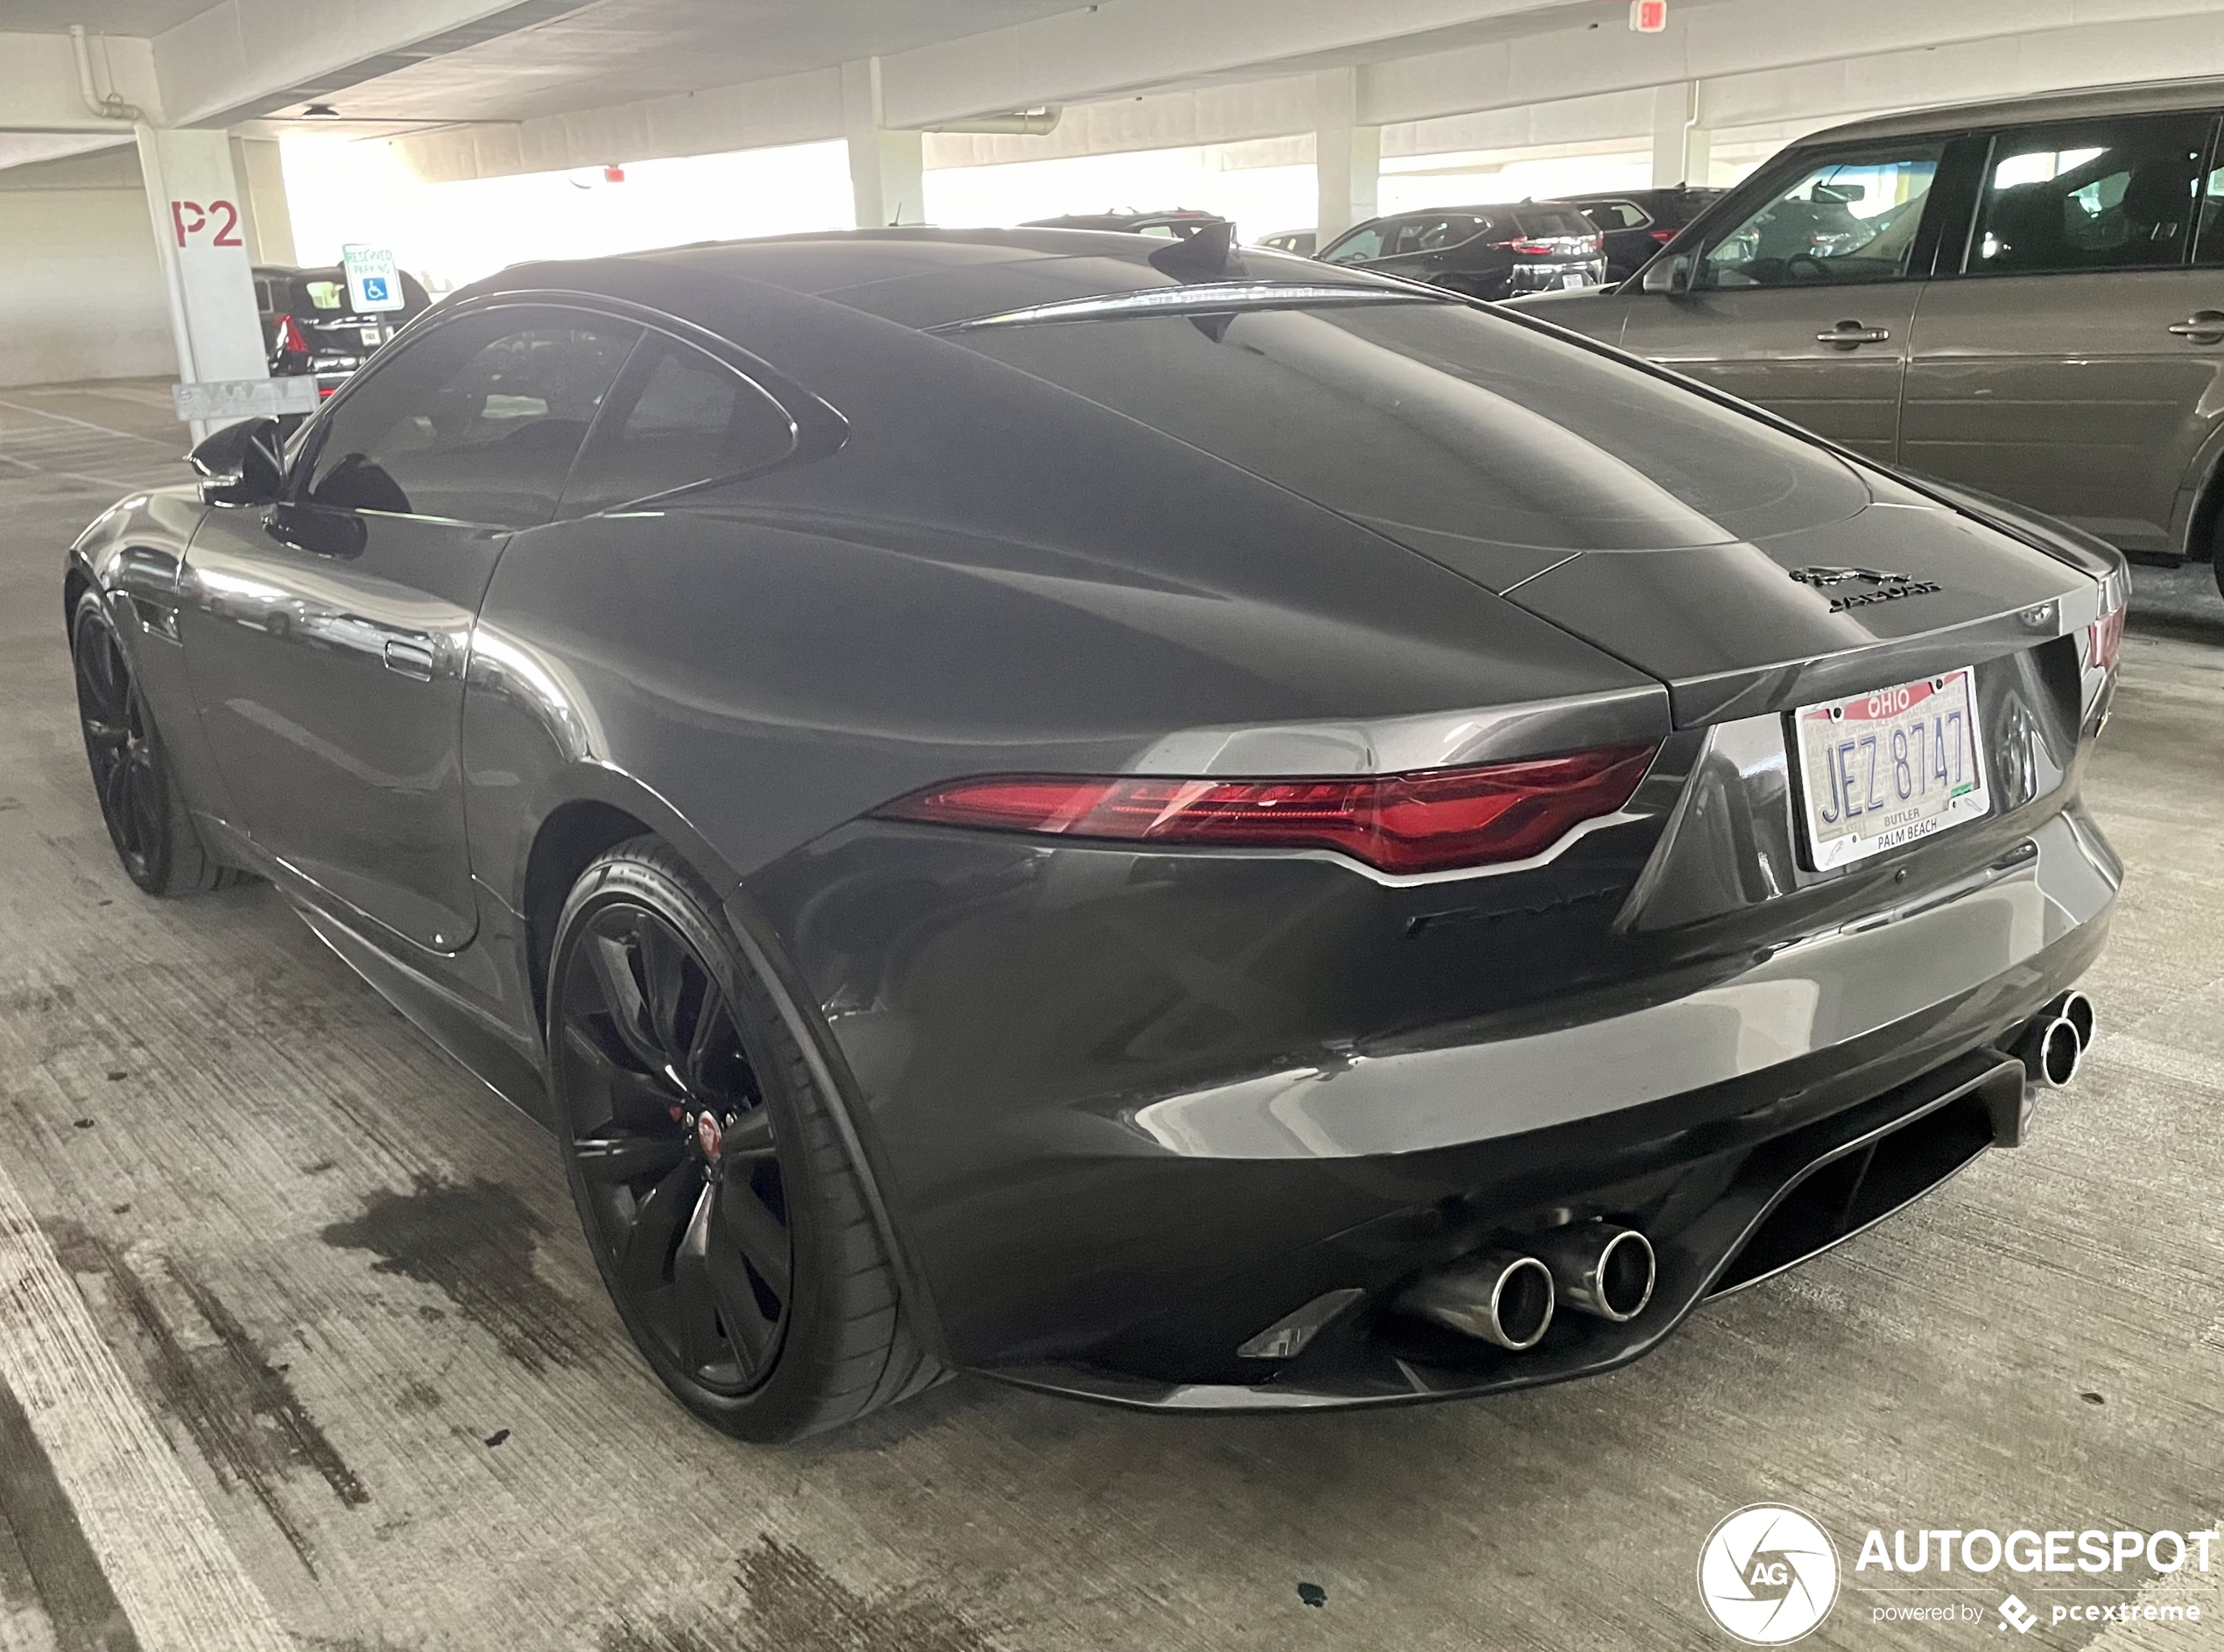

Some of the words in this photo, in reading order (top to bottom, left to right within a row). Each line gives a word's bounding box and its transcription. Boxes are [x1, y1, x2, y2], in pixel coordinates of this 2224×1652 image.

[171, 200, 243, 248] P2
[346, 249, 393, 263] RESERVED
[1868, 688, 1910, 718] OHIO
[1822, 735, 1884, 823] JEZ
[1893, 711, 1961, 799] 8747
[1884, 808, 1919, 827] BUTLER
[1877, 831, 1905, 850] PALM
[1908, 819, 1938, 840] BEACH
